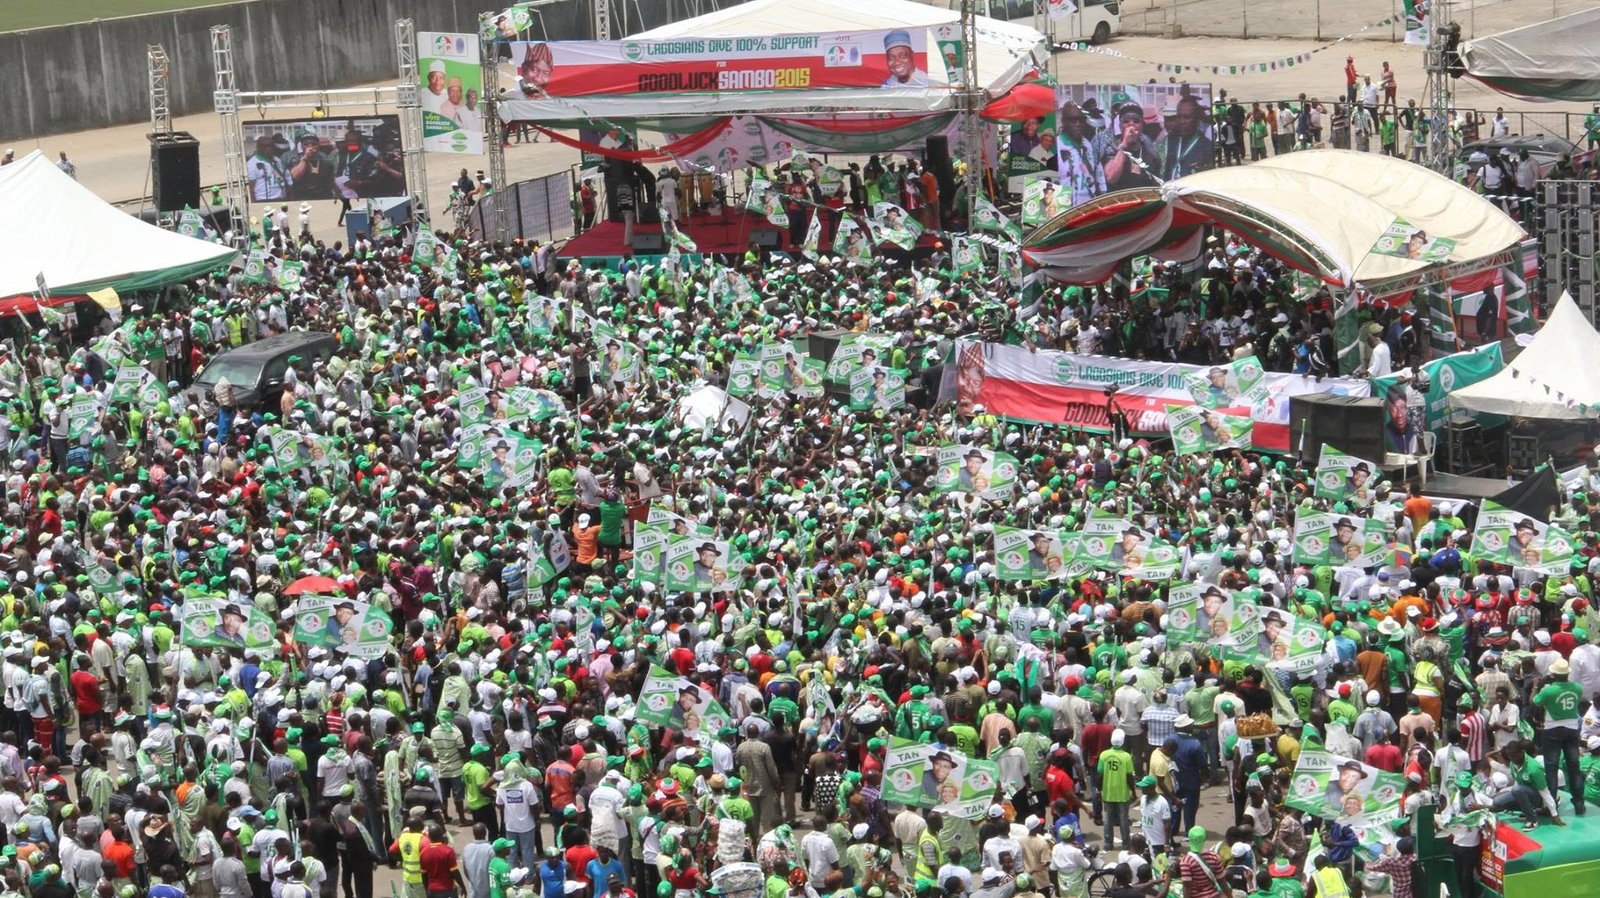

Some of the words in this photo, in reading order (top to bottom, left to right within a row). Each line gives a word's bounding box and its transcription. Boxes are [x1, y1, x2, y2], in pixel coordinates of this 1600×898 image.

[647, 41, 705, 55] LAGOSIANS
[708, 39, 732, 53] GIVE
[736, 38, 767, 52] 100%
[771, 36, 820, 50] SUPPORT
[1078, 365, 1136, 385] LAGOSIANS
[1140, 372, 1164, 388] GIVE
[1095, 523, 1114, 531] TAN
[1305, 520, 1325, 529] TAN
[1145, 570, 1166, 578] TAN
[1172, 591, 1192, 600] TAN
[193, 603, 212, 611] TAN
[307, 599, 326, 607] TAN
[1016, 619, 1026, 631] 15
[362, 646, 381, 654] TAN
[1295, 658, 1315, 668] TAN
[1560, 697, 1575, 710] 15
[898, 751, 920, 761] TAN
[1108, 761, 1119, 771] 15
[1305, 757, 1327, 766] TAN
[964, 803, 985, 814] TAN
